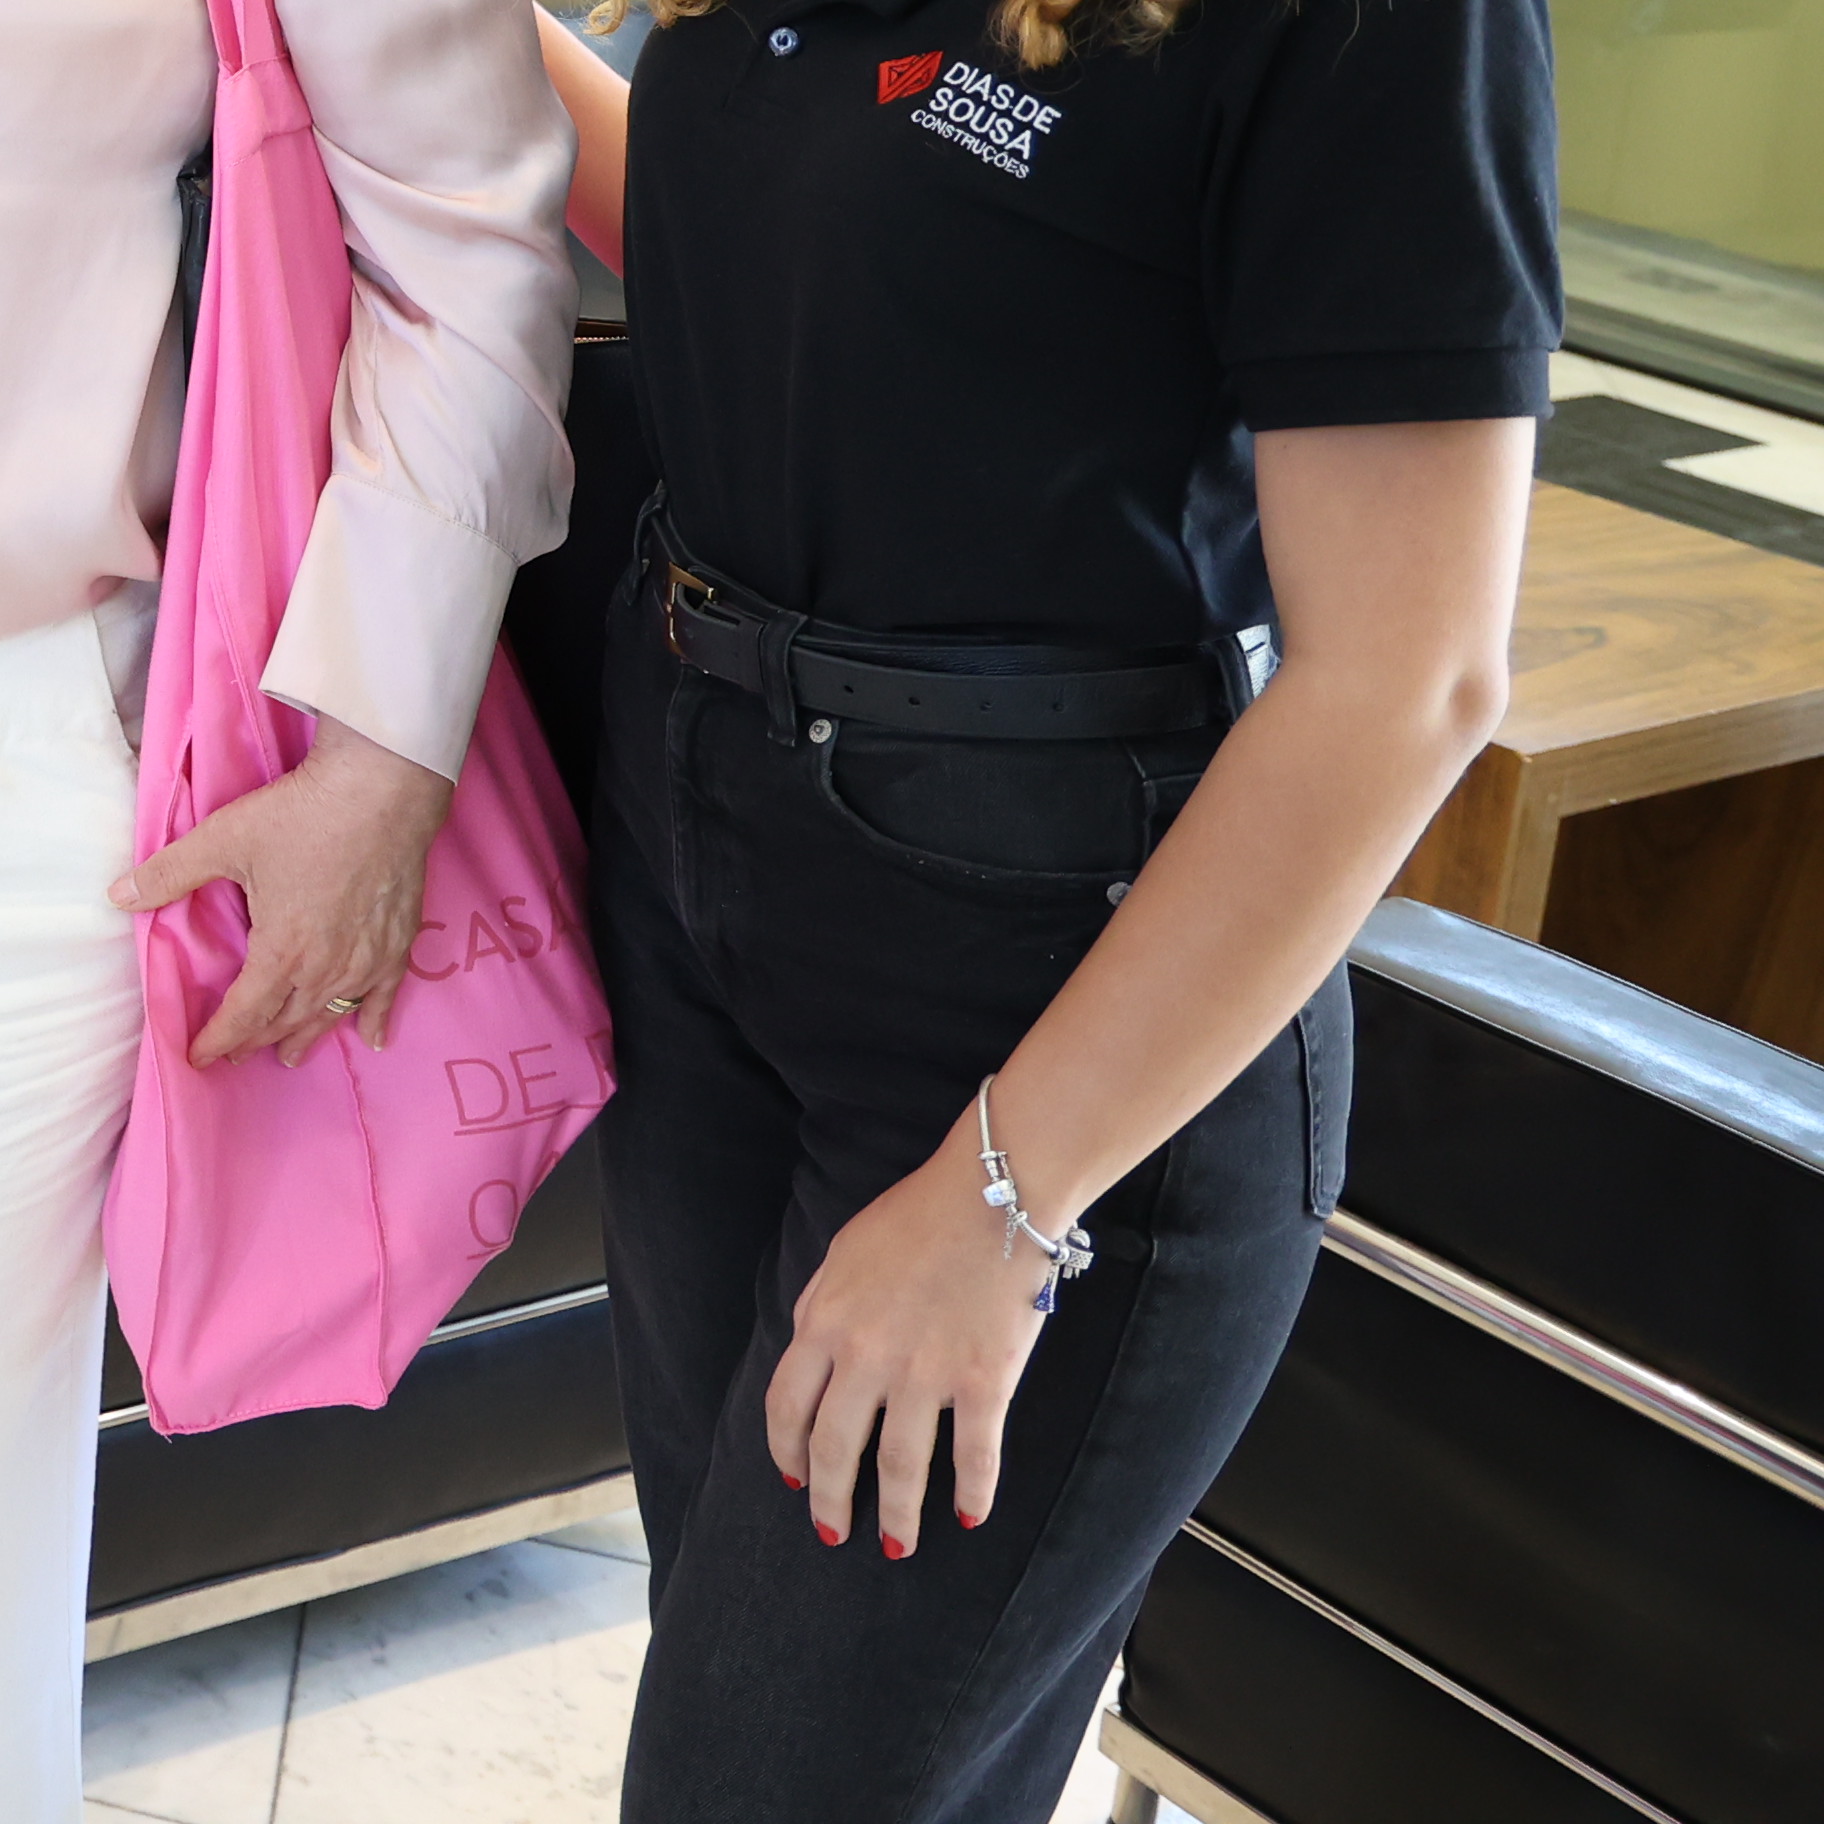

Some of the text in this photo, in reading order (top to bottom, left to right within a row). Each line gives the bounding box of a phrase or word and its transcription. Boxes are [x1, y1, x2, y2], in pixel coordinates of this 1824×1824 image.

[928, 86, 1033, 160] SOUSA
[942, 60, 1063, 135] DIAS DE
[444, 1043, 567, 1126] DE
